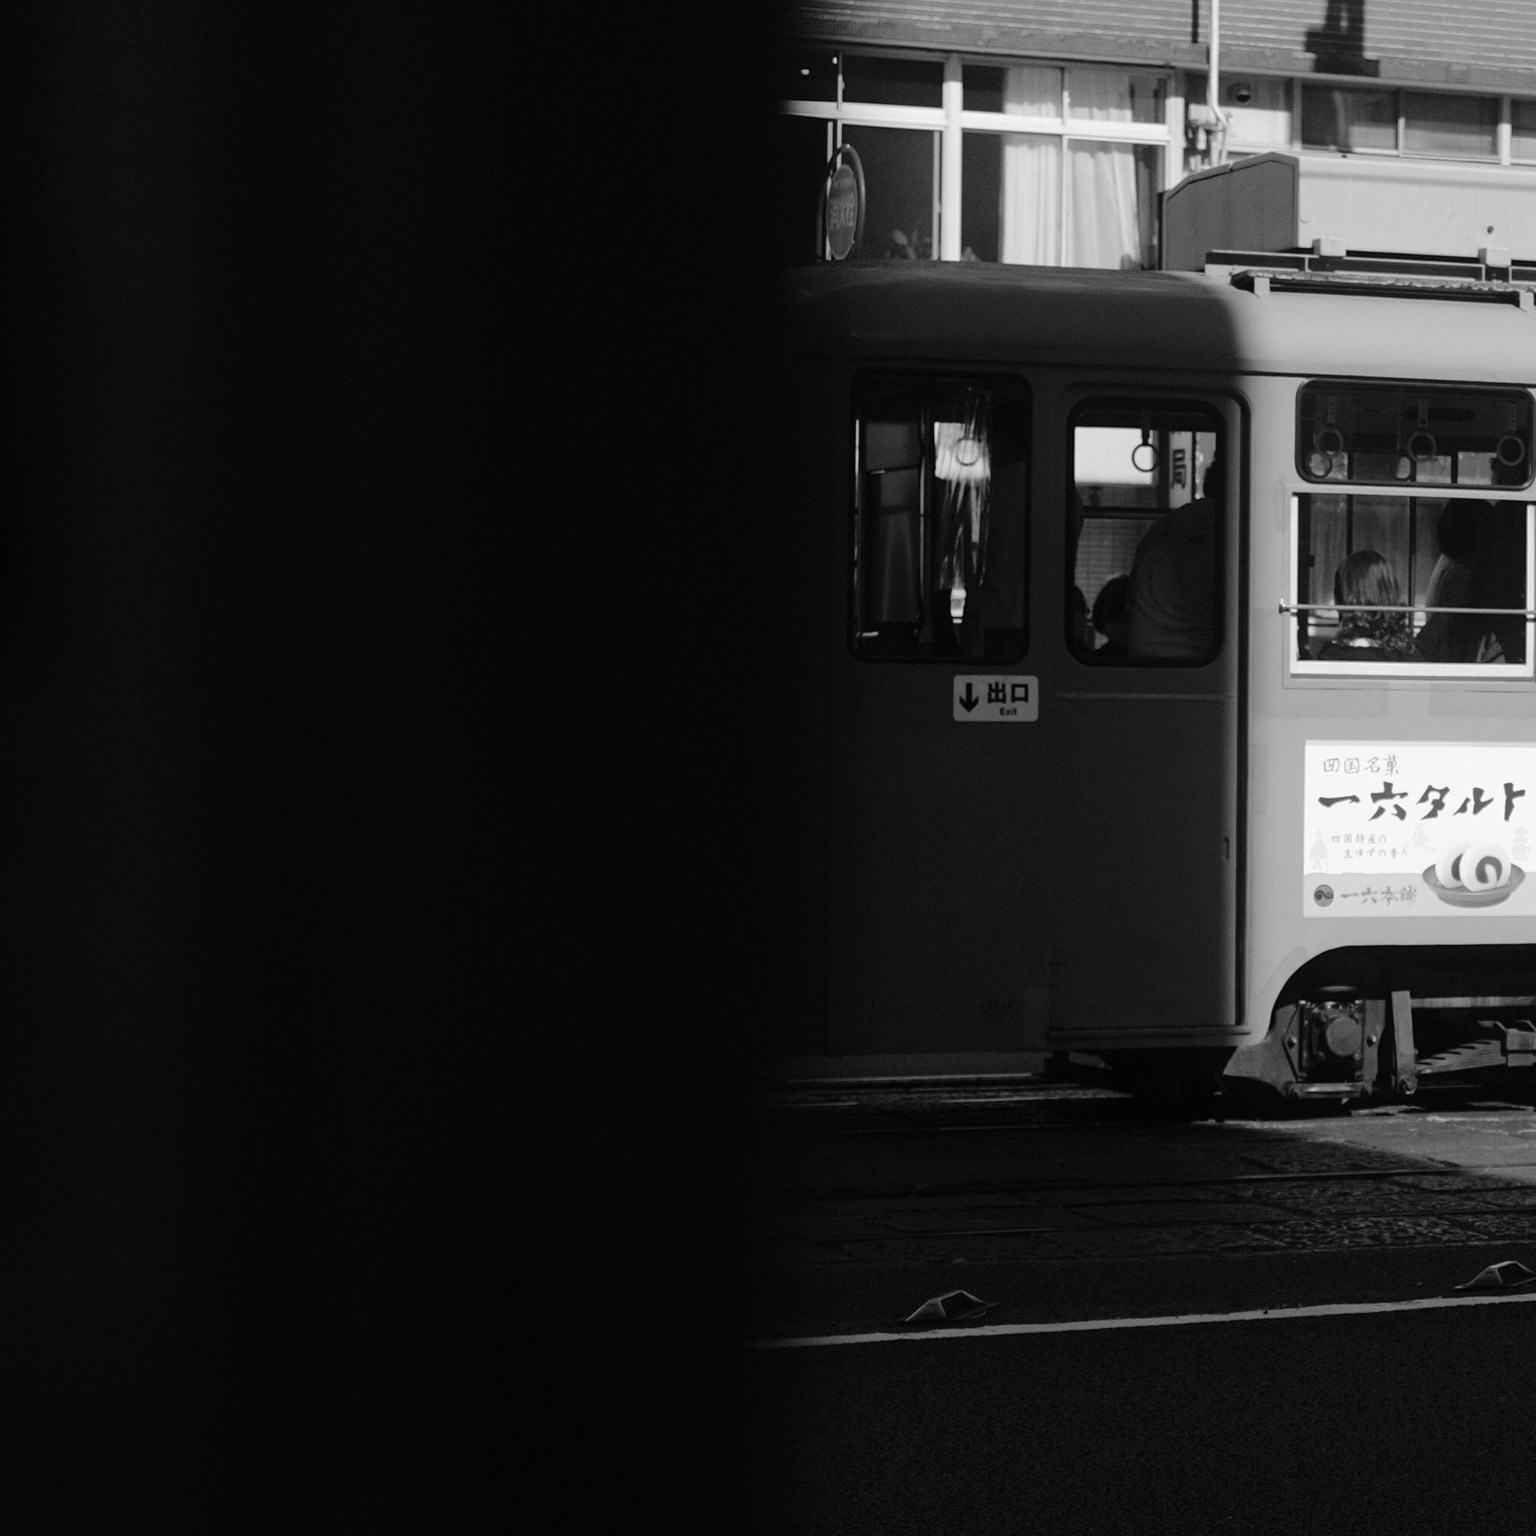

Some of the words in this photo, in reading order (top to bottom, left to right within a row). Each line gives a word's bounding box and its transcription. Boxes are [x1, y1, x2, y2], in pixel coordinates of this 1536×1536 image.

[988, 682, 1028, 704] 出口
[1000, 707, 1017, 716] Exit
[1323, 754, 1400, 776] 四国名菓
[1318, 781, 1526, 822] 一六タルト
[1331, 833, 1387, 844] 四国特産の
